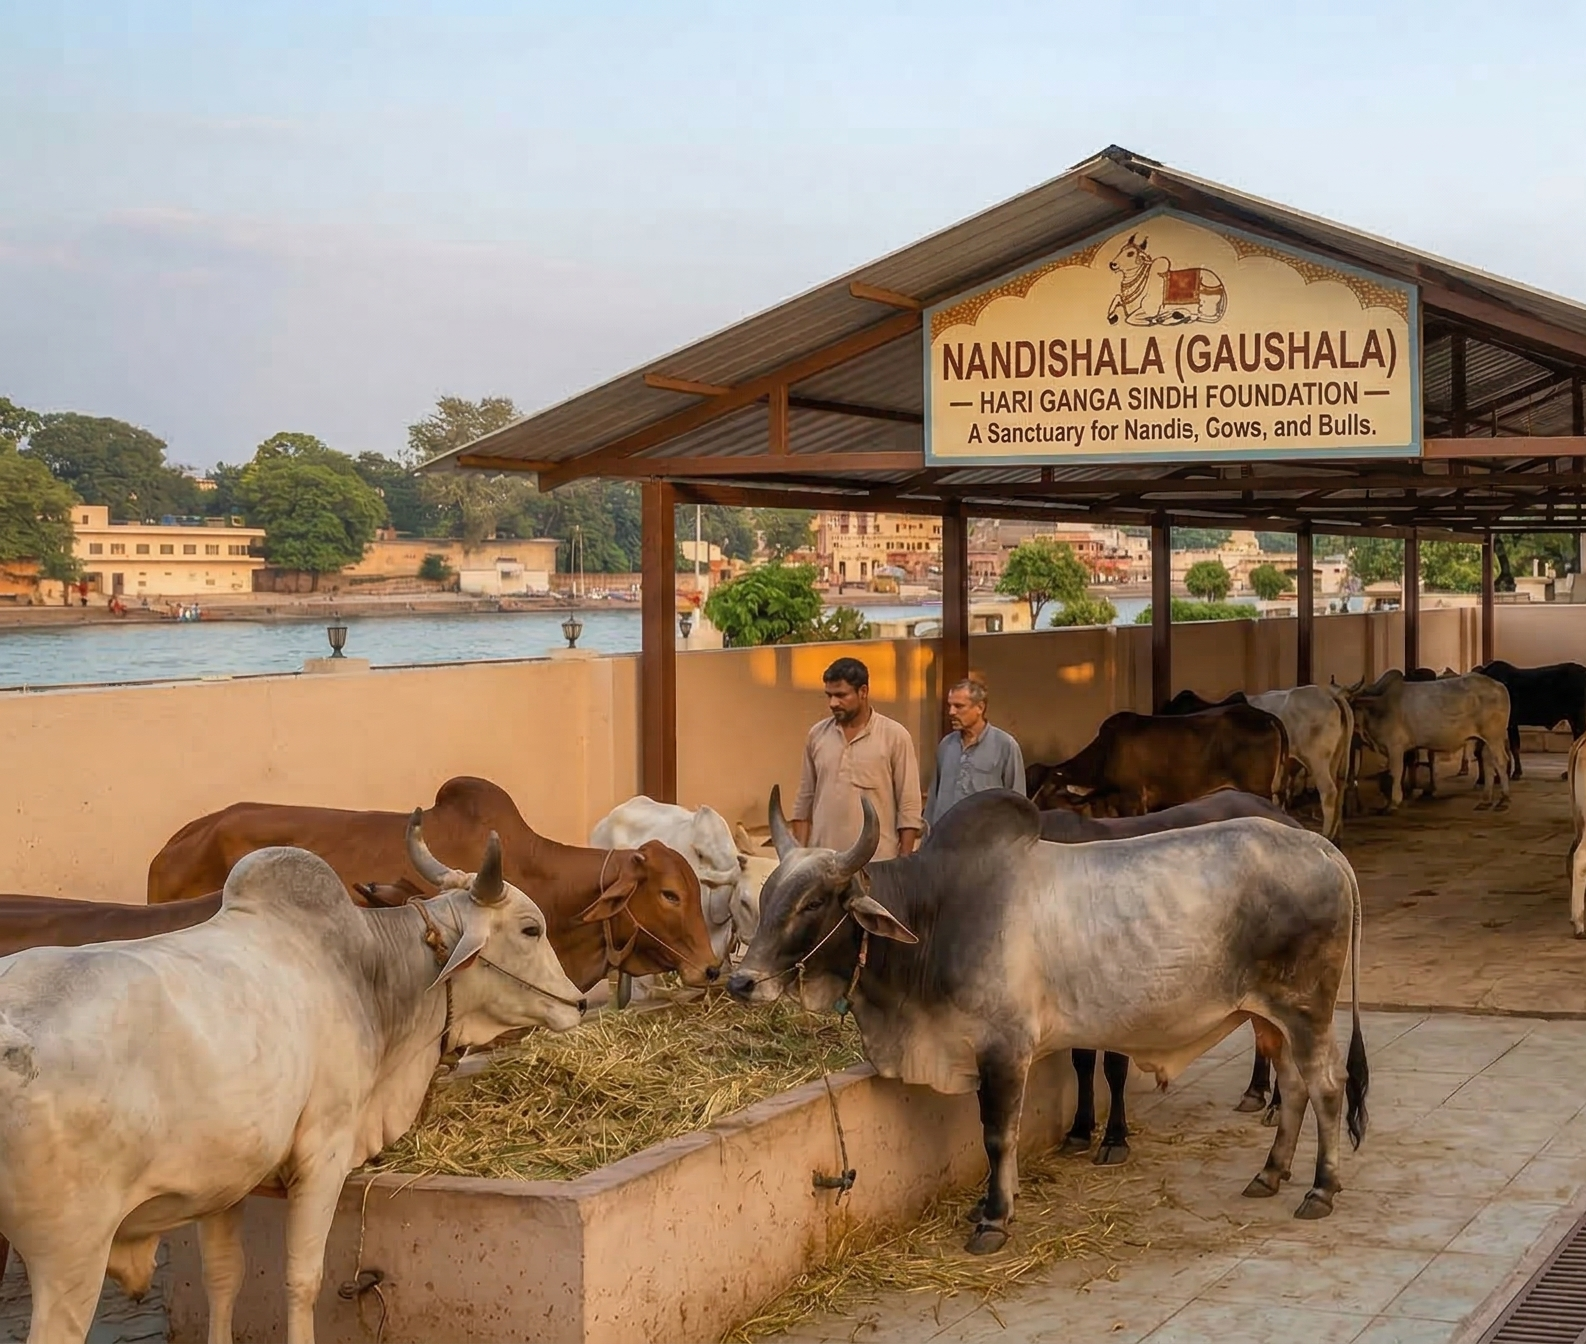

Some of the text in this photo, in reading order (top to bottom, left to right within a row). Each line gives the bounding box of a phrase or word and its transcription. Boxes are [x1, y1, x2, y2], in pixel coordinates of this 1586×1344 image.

[944, 328, 1397, 385] NANDISHALA (GAUSHALA)
[980, 381, 1358, 414] HARI GANGA SINDH FOUNDATION
[967, 423, 983, 444] A
[987, 420, 1086, 448] Sanctuary
[1090, 420, 1119, 442] for
[1124, 417, 1199, 443] Nandis,
[1273, 413, 1312, 438] and
[1318, 413, 1377, 437] Bulls.
